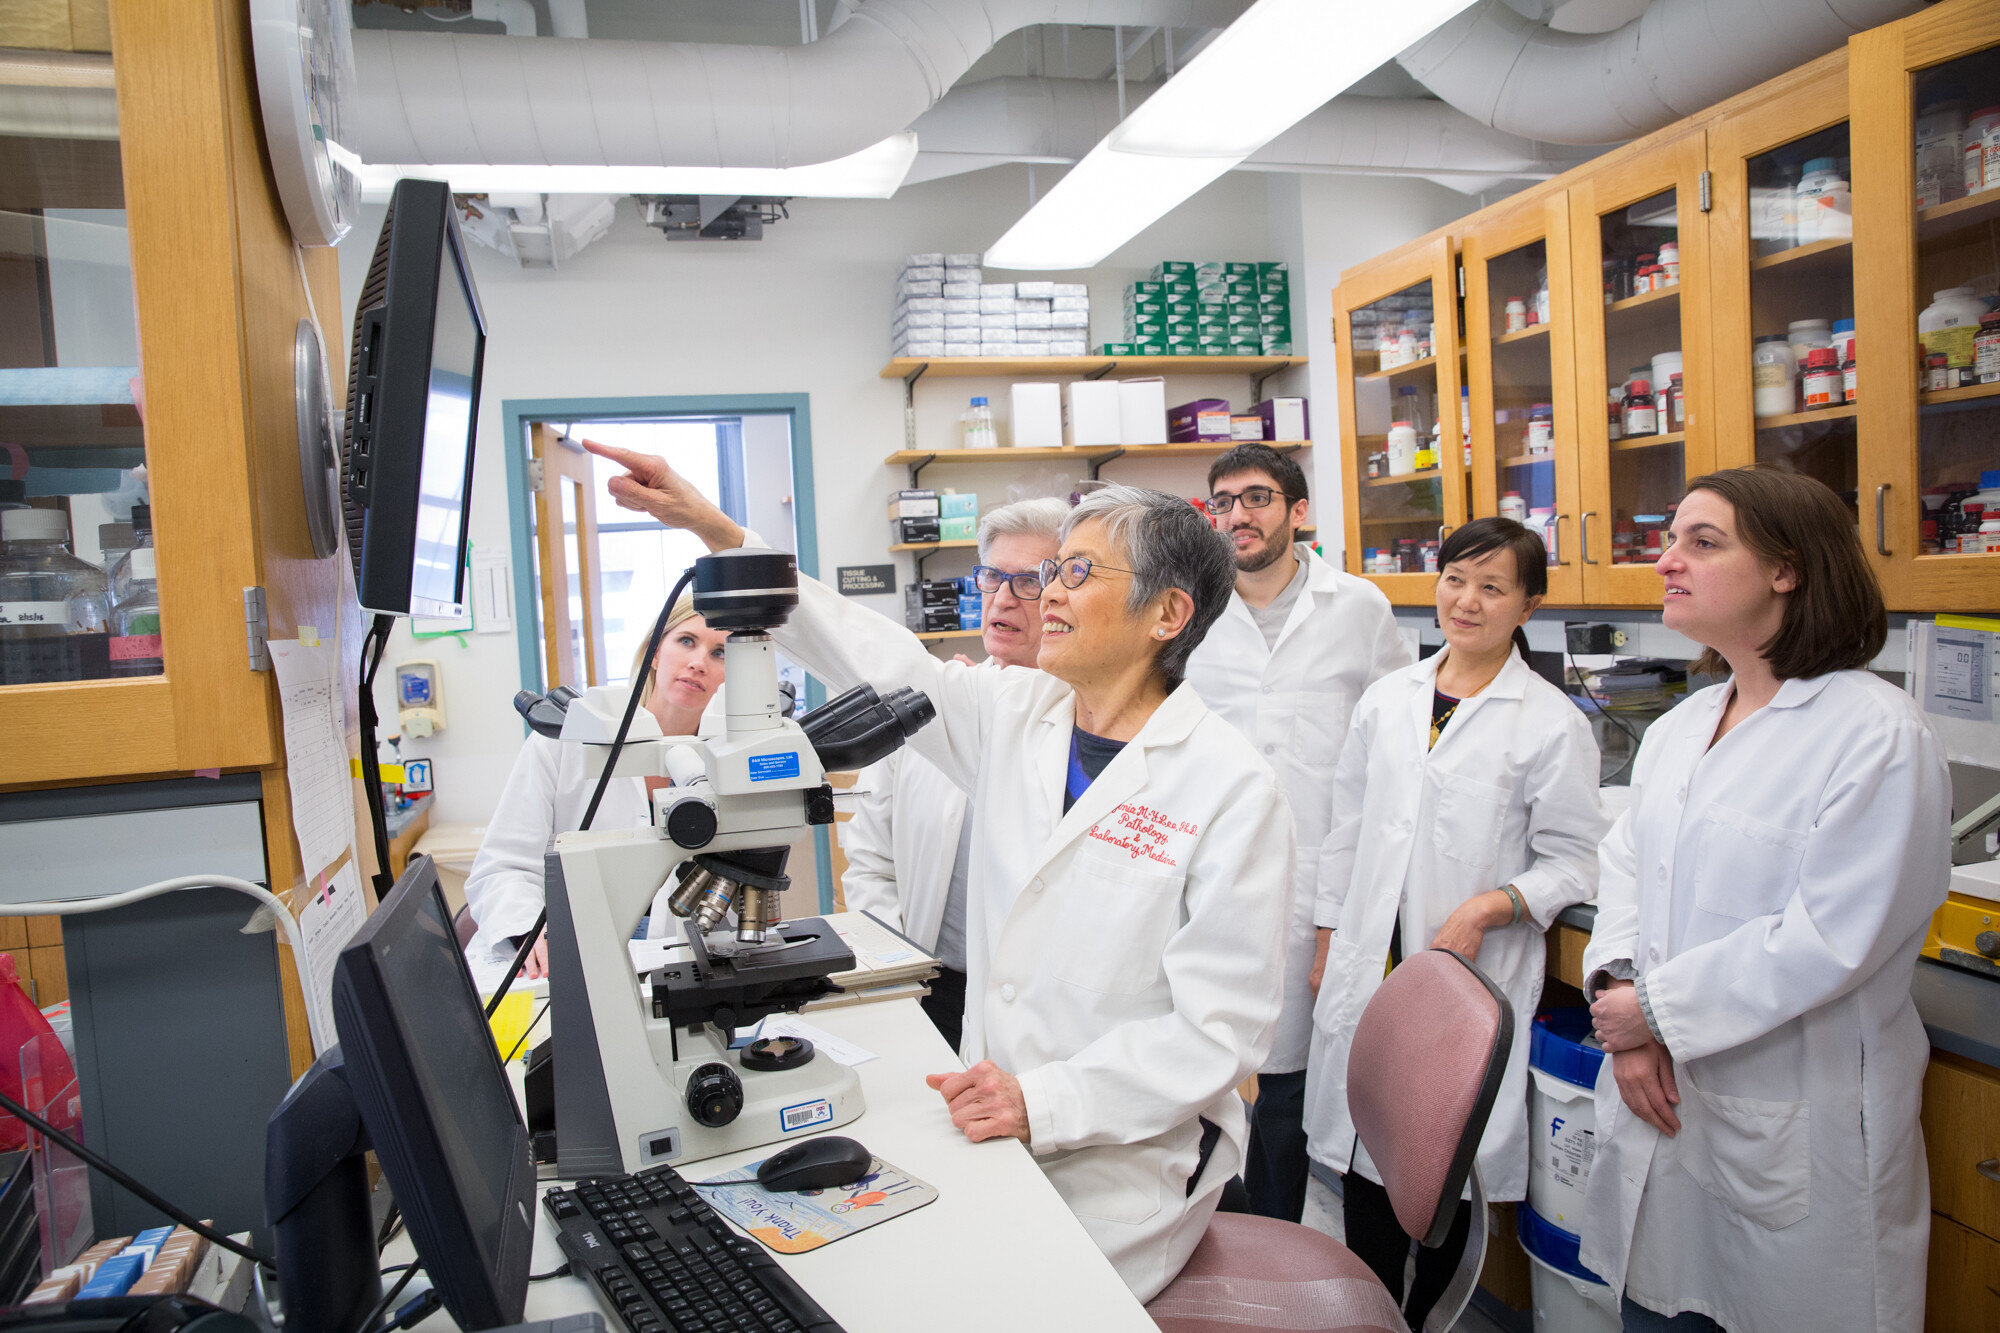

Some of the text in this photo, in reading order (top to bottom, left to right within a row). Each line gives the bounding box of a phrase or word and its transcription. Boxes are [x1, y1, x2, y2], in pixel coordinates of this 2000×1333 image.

[842, 569, 865, 577] TISSUE
[842, 575, 872, 584] CUTTING
[842, 581, 886, 590] PROCESSING
[1133, 834, 1141, 843] &
[1550, 1117, 1566, 1137] F
[737, 1197, 802, 1240] Thank You!
[582, 1231, 600, 1249] DELL
